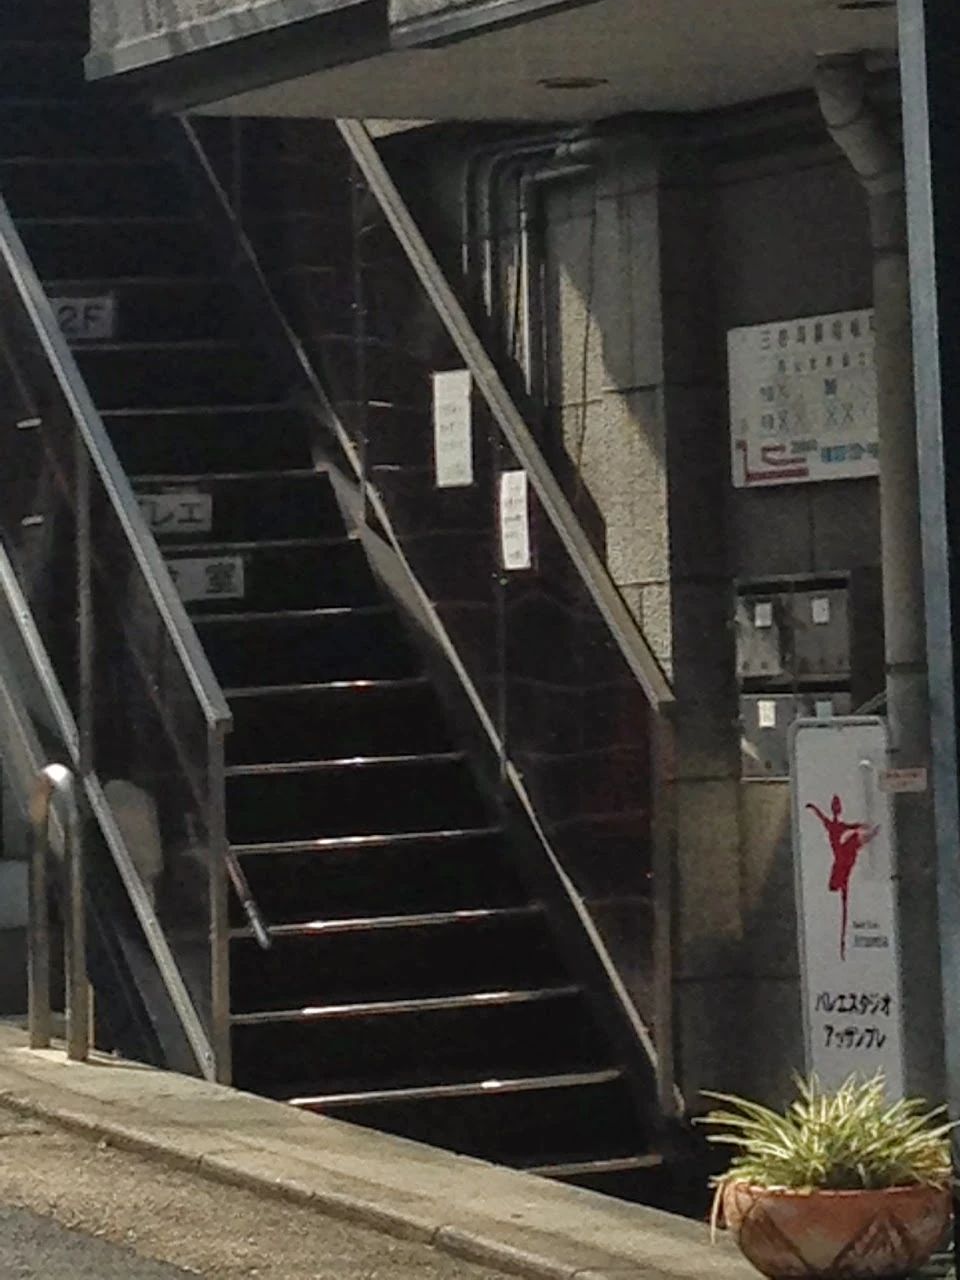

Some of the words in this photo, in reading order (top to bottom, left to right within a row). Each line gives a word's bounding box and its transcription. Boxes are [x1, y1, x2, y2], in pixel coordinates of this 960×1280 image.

[814, 990, 892, 1018] バレエスタジオ
